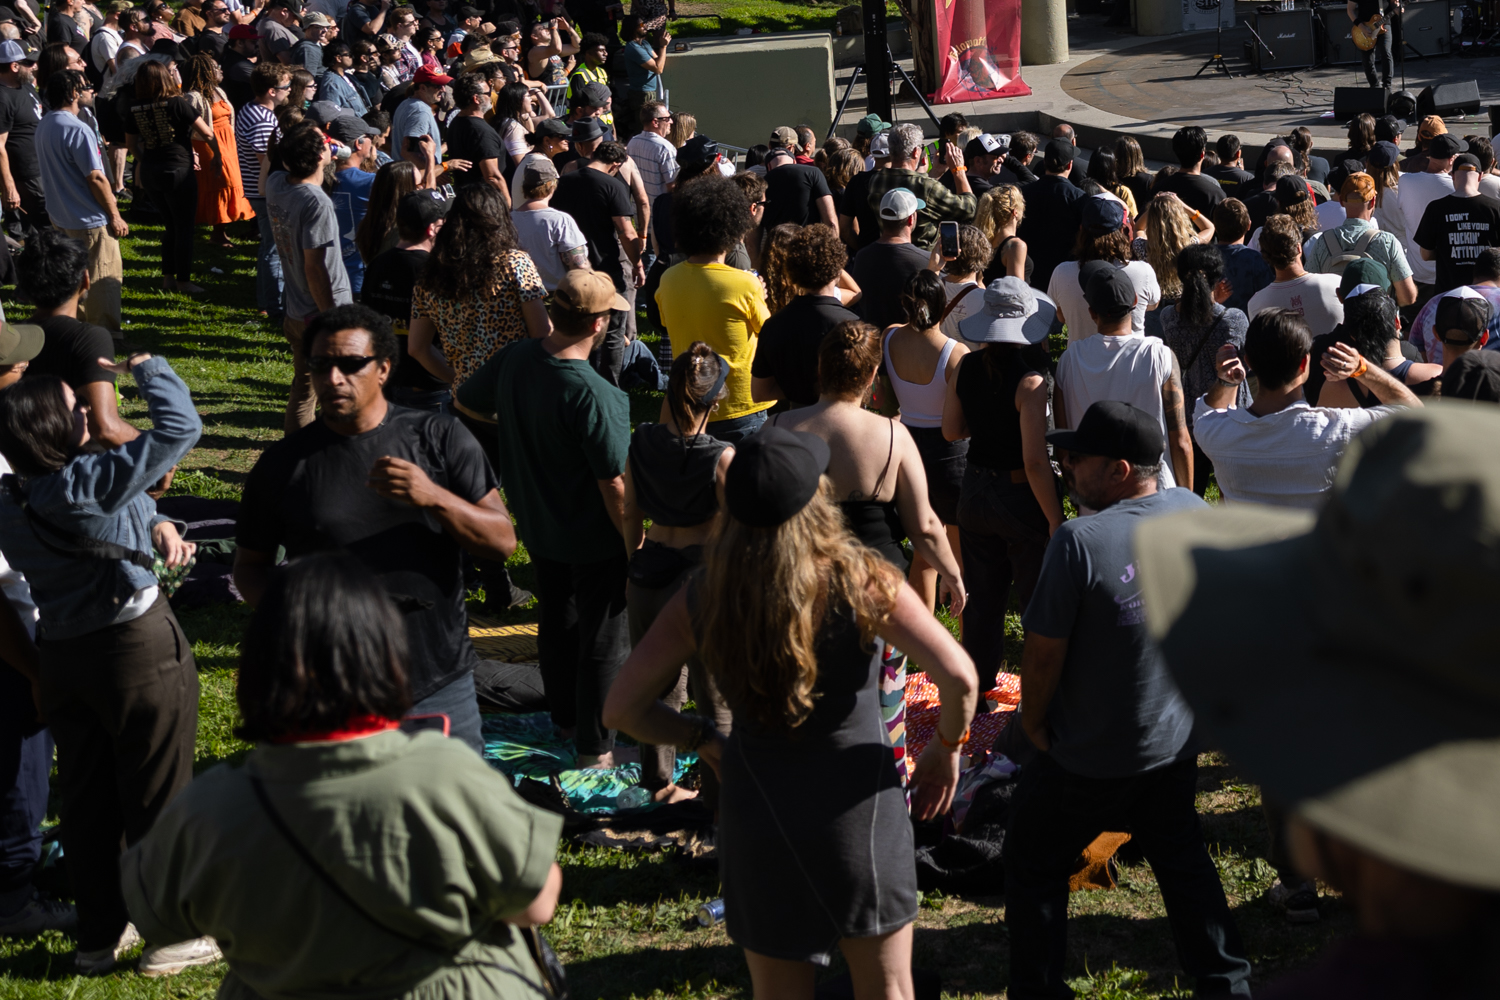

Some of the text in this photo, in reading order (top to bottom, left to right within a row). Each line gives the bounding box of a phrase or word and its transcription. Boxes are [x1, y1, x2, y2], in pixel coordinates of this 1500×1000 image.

[949, 36, 987, 61] klowatt
[1445, 212, 1470, 222] I DON'T
[1457, 222, 1490, 231] LIKE YOUR
[1448, 232, 1480, 245] FUCKIN'
[1450, 245, 1490, 258] ATTITU
